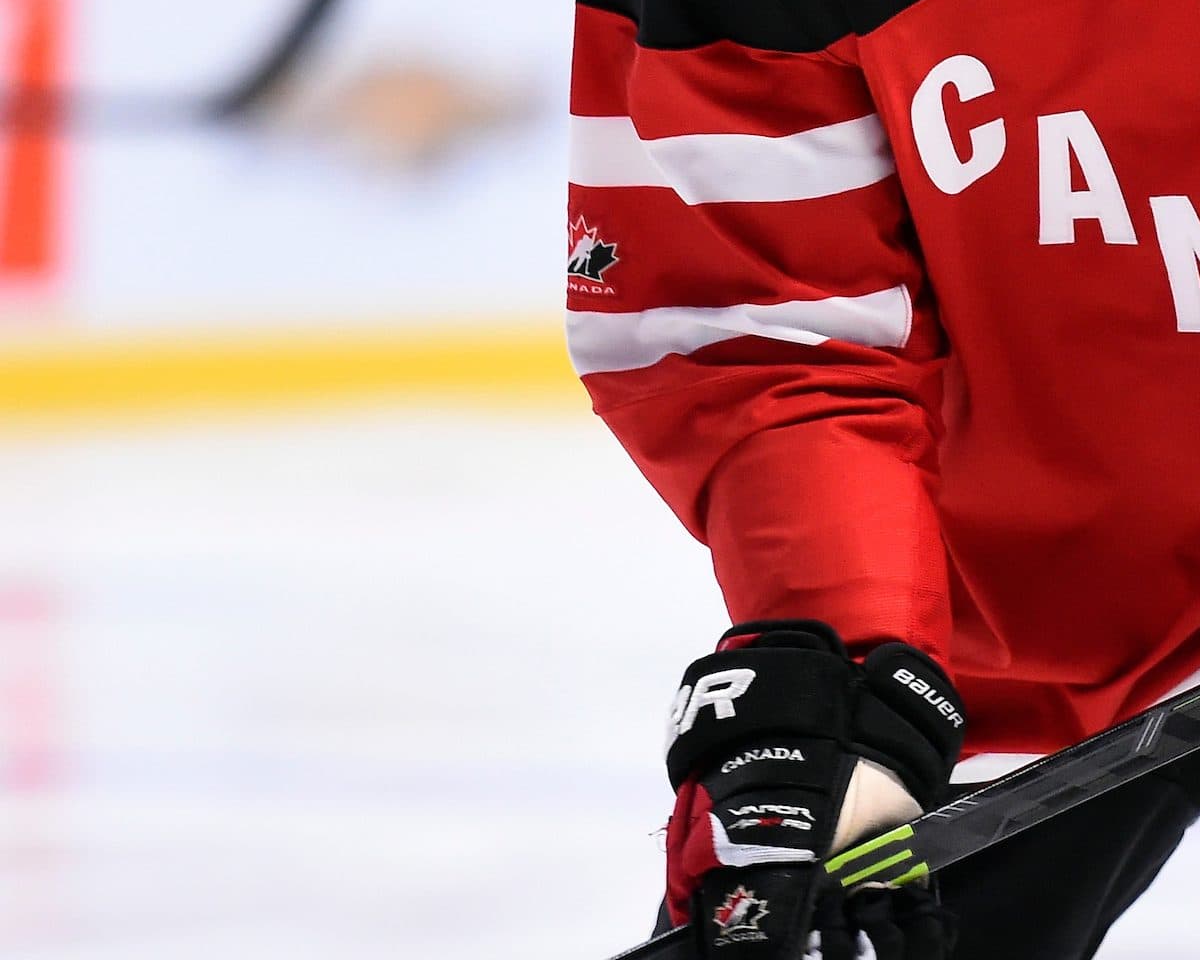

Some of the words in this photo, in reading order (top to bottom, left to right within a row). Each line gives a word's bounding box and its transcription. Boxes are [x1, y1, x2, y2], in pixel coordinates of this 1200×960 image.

[569, 281, 616, 295] NADA
[892, 668, 964, 728] BAUER
[721, 747, 805, 773] CANADA
